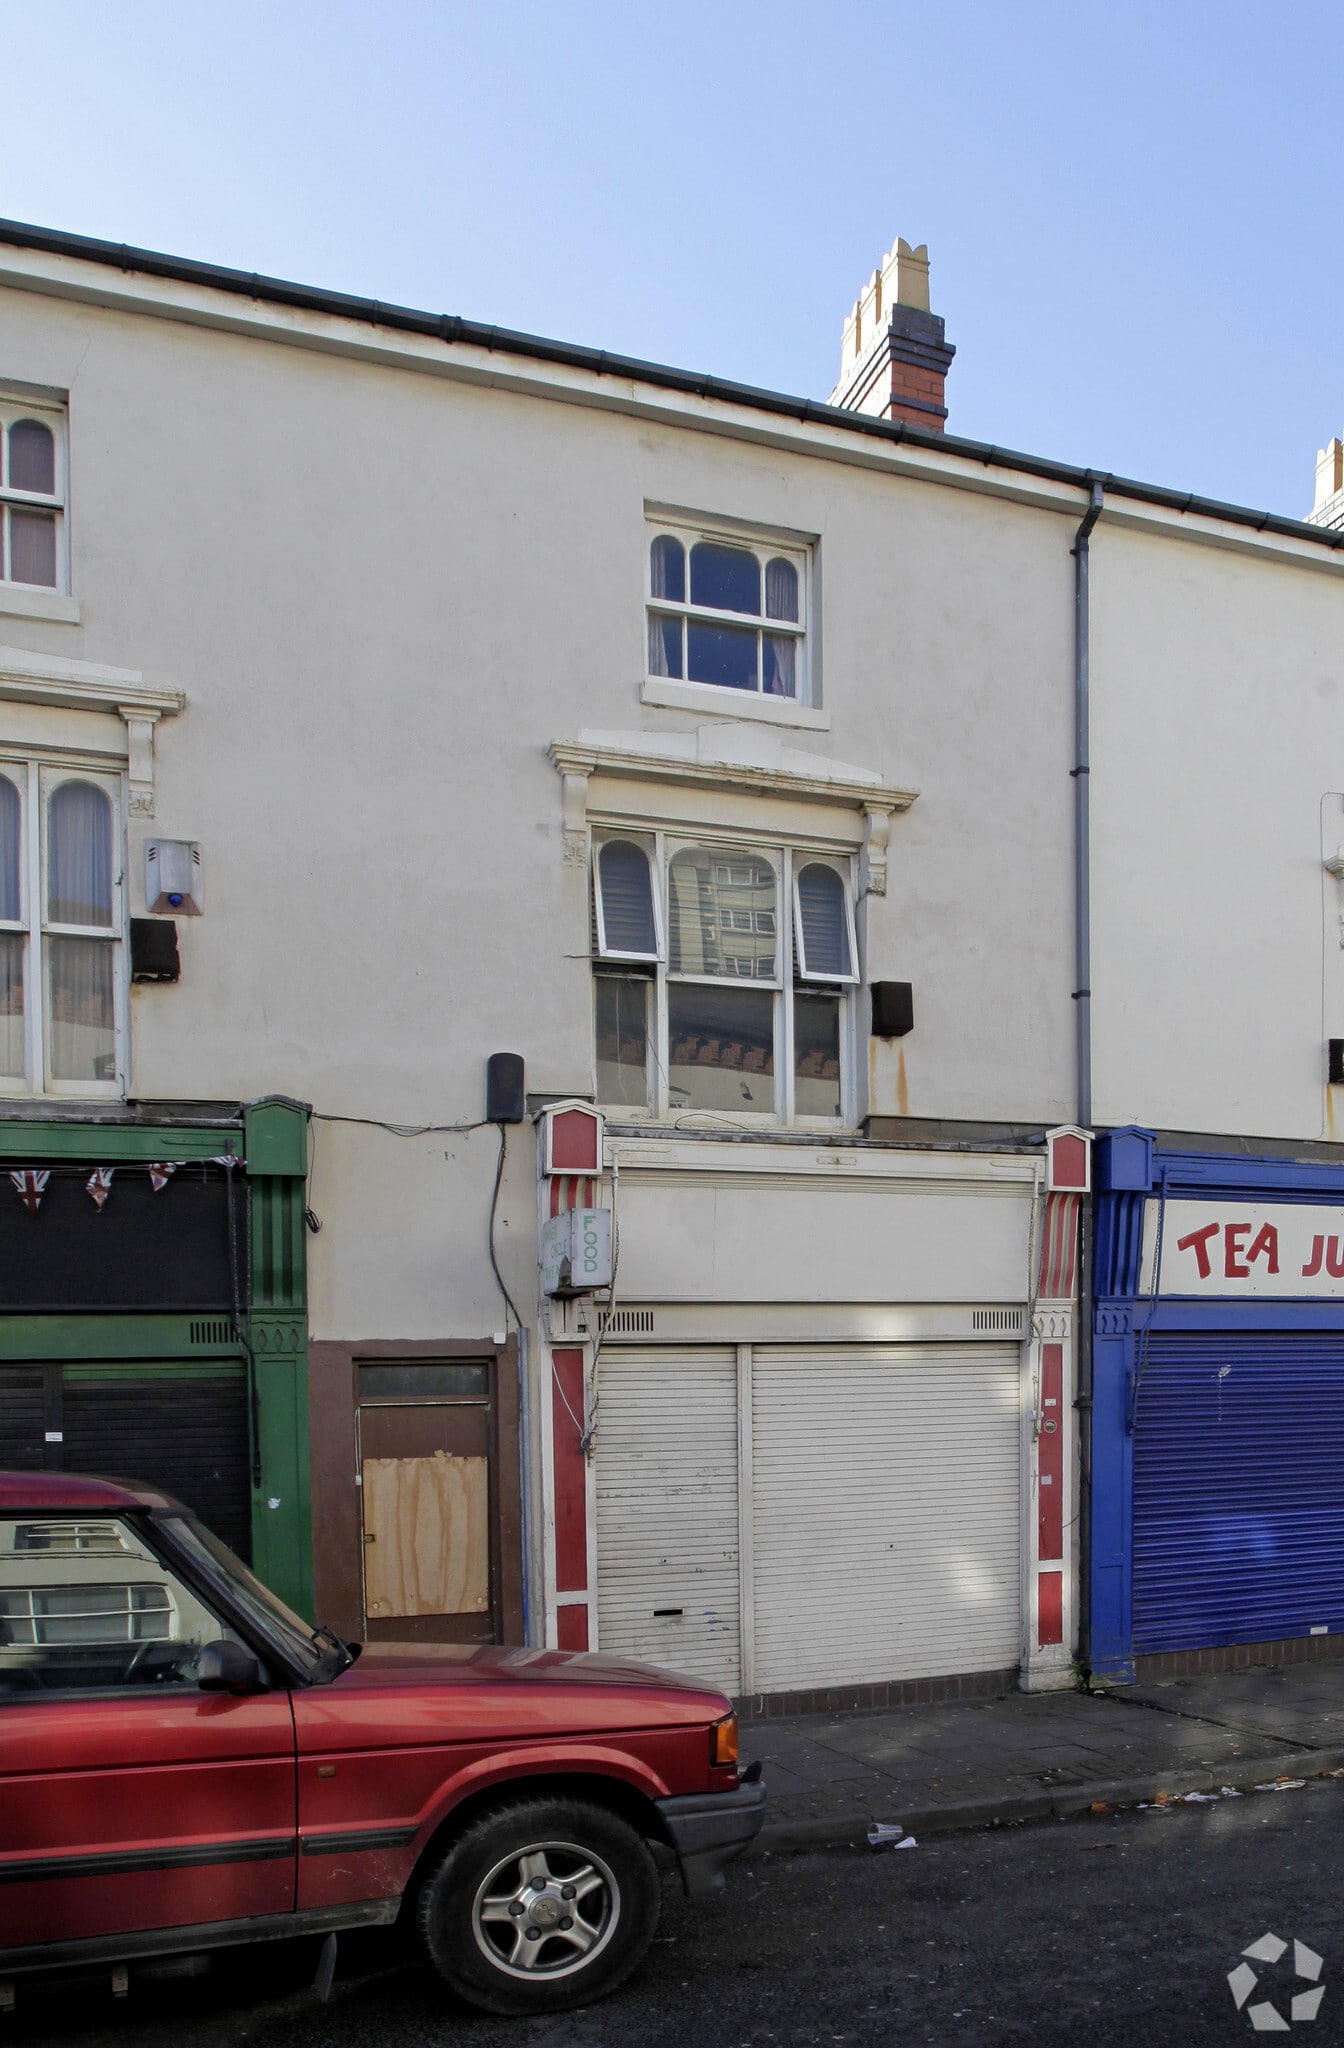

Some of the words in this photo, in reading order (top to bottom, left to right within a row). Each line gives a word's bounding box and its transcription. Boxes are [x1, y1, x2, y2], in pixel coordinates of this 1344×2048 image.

[583, 1215, 598, 1273] FOOD
[1177, 1222, 1280, 1279] TEA
[1302, 1235, 1344, 1279] JU
